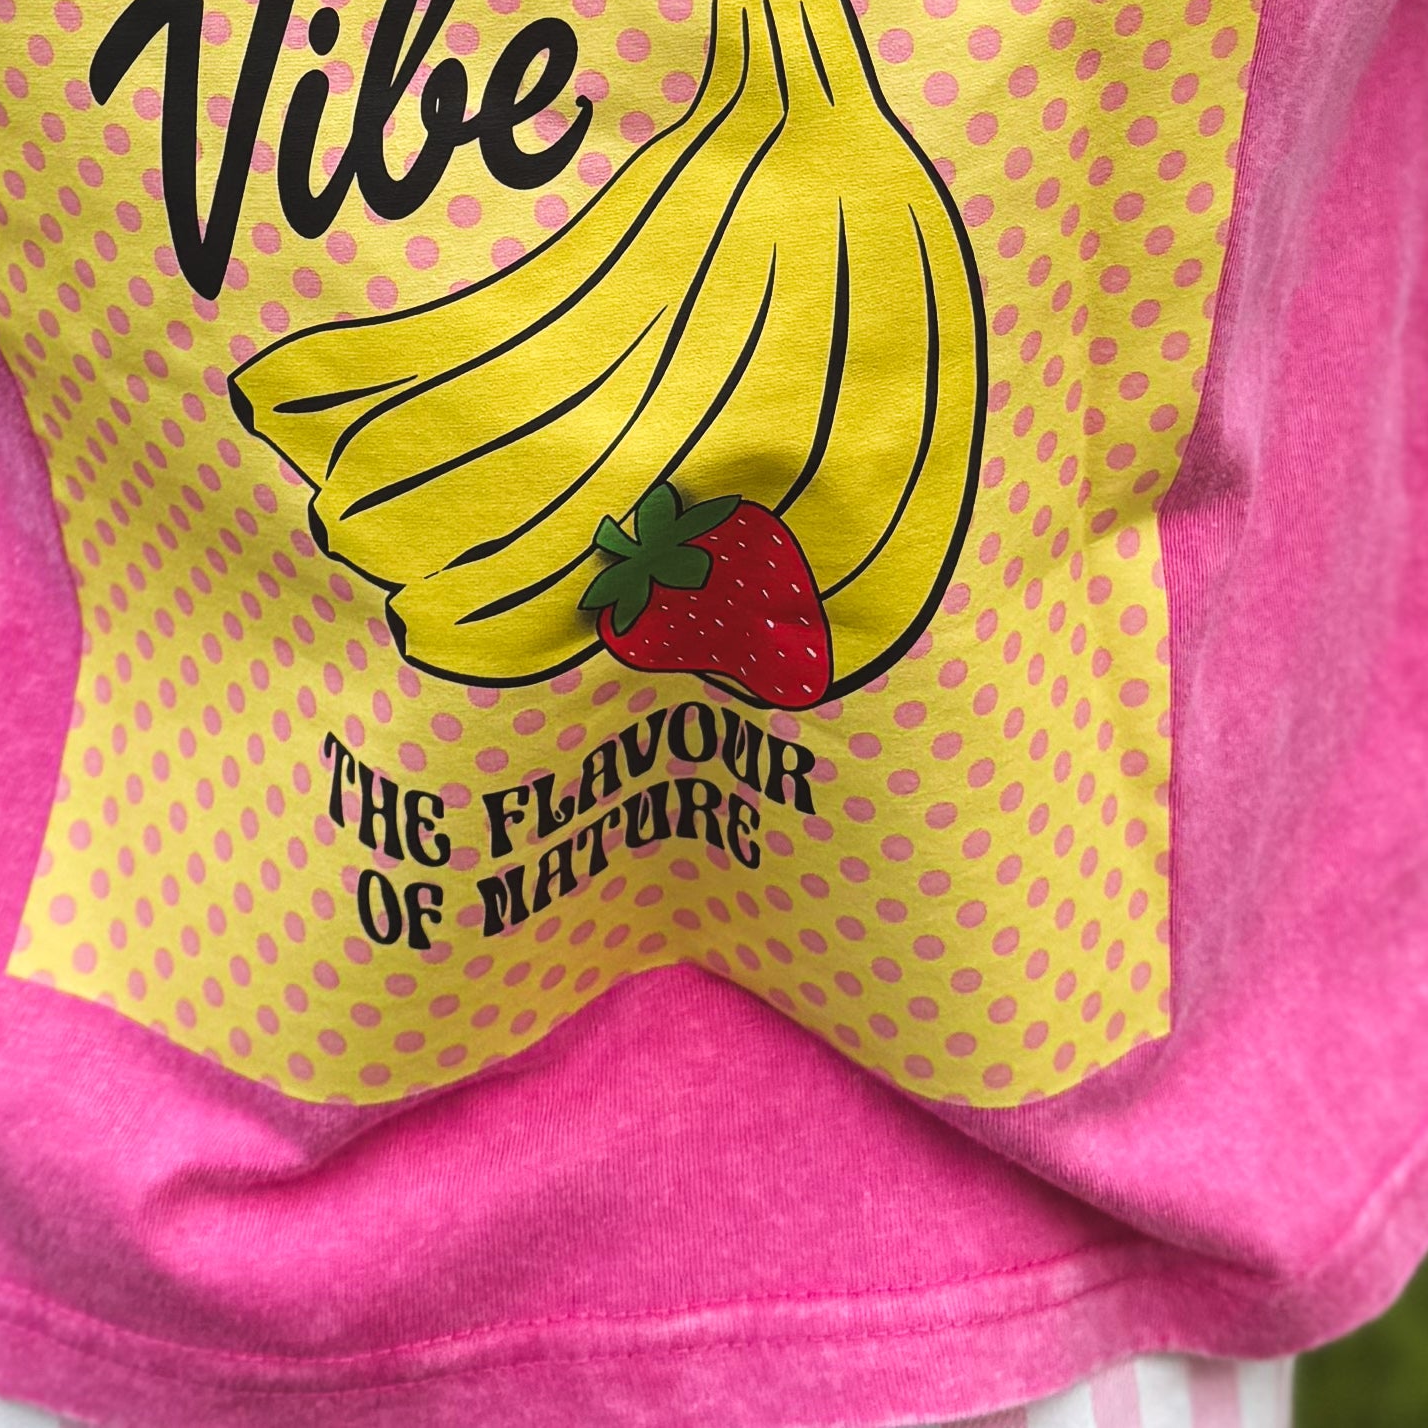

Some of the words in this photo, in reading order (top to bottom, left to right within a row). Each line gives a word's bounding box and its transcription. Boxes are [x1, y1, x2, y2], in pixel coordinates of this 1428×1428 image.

[324, 731, 451, 867] THE
[482, 701, 816, 858] FLAVOUR
[357, 868, 443, 950] OF
[476, 777, 761, 937] NATURE
